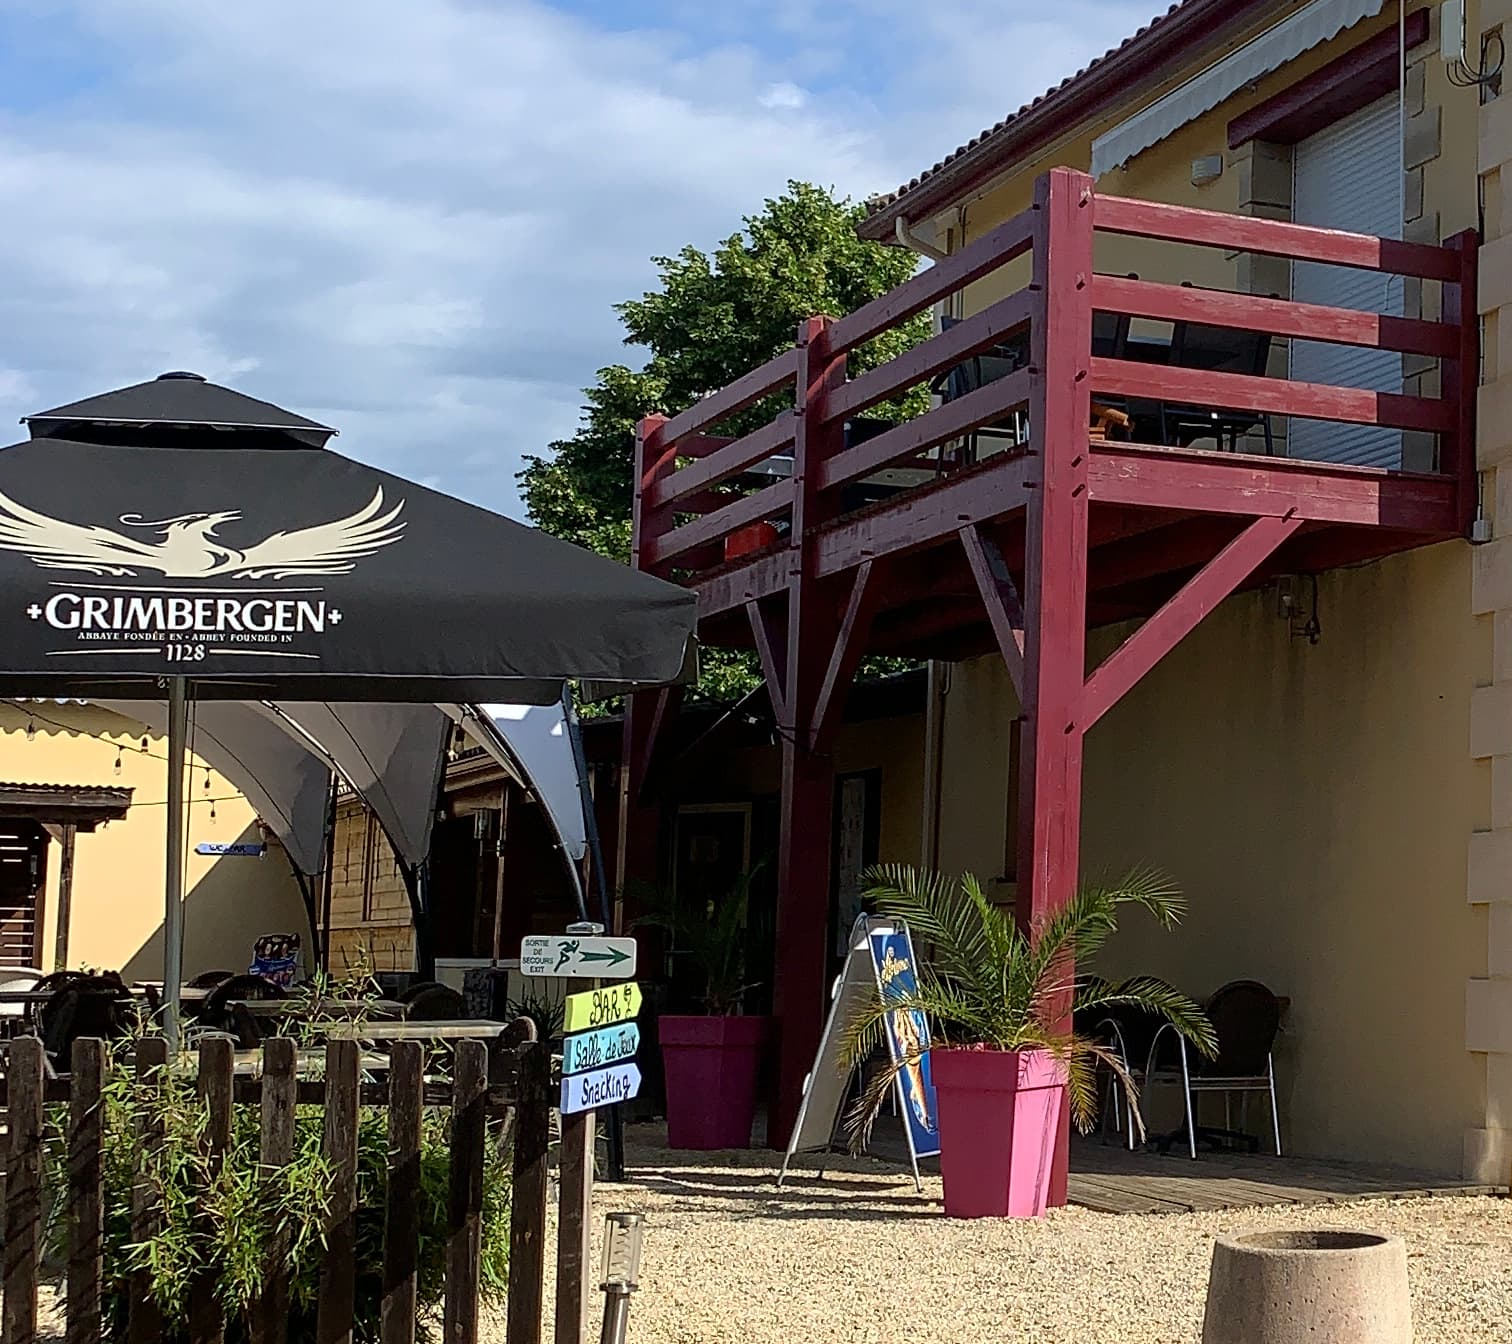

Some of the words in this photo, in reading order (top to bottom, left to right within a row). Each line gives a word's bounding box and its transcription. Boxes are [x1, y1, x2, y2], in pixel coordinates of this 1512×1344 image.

[45, 593, 326, 633] GRIMBERGEN
[77, 631, 120, 641] ABBAYE
[169, 633, 184, 641] EN
[191, 633, 226, 642] ABBEY
[230, 634, 278, 642] FOUNDED
[281, 634, 293, 643] IN
[166, 643, 206, 662] 1128
[525, 939, 549, 947] SORTIE
[522, 957, 554, 965] SECOURS
[590, 990, 621, 1025] BAR
[575, 1033, 602, 1069] Salle
[605, 1036, 617, 1061] de
